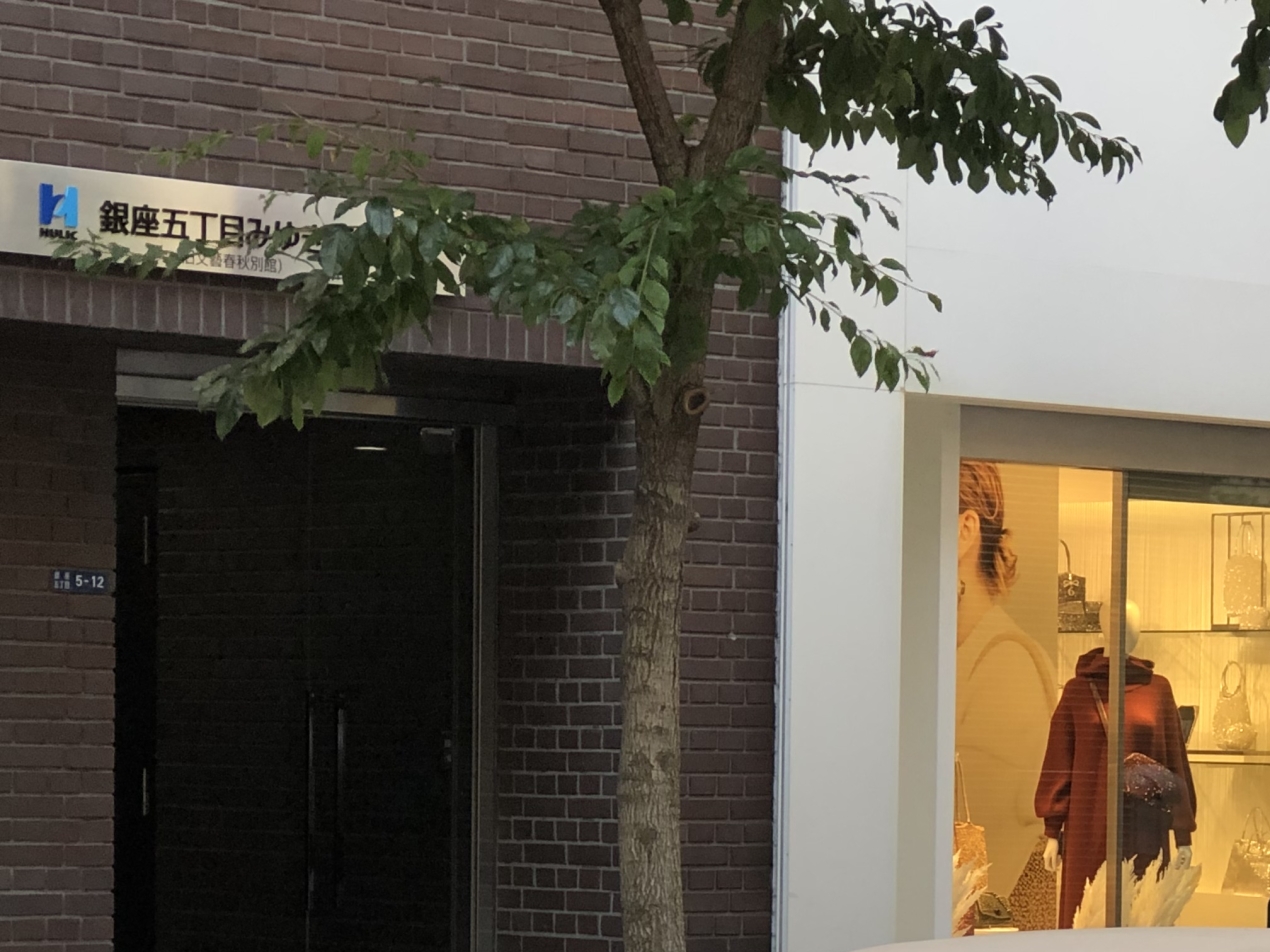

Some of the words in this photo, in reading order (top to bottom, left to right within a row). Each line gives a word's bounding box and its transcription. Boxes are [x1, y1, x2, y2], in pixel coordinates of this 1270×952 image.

[99, 200, 322, 252] 銀座五丁目みゆ
[75, 574, 105, 589] 5-12
